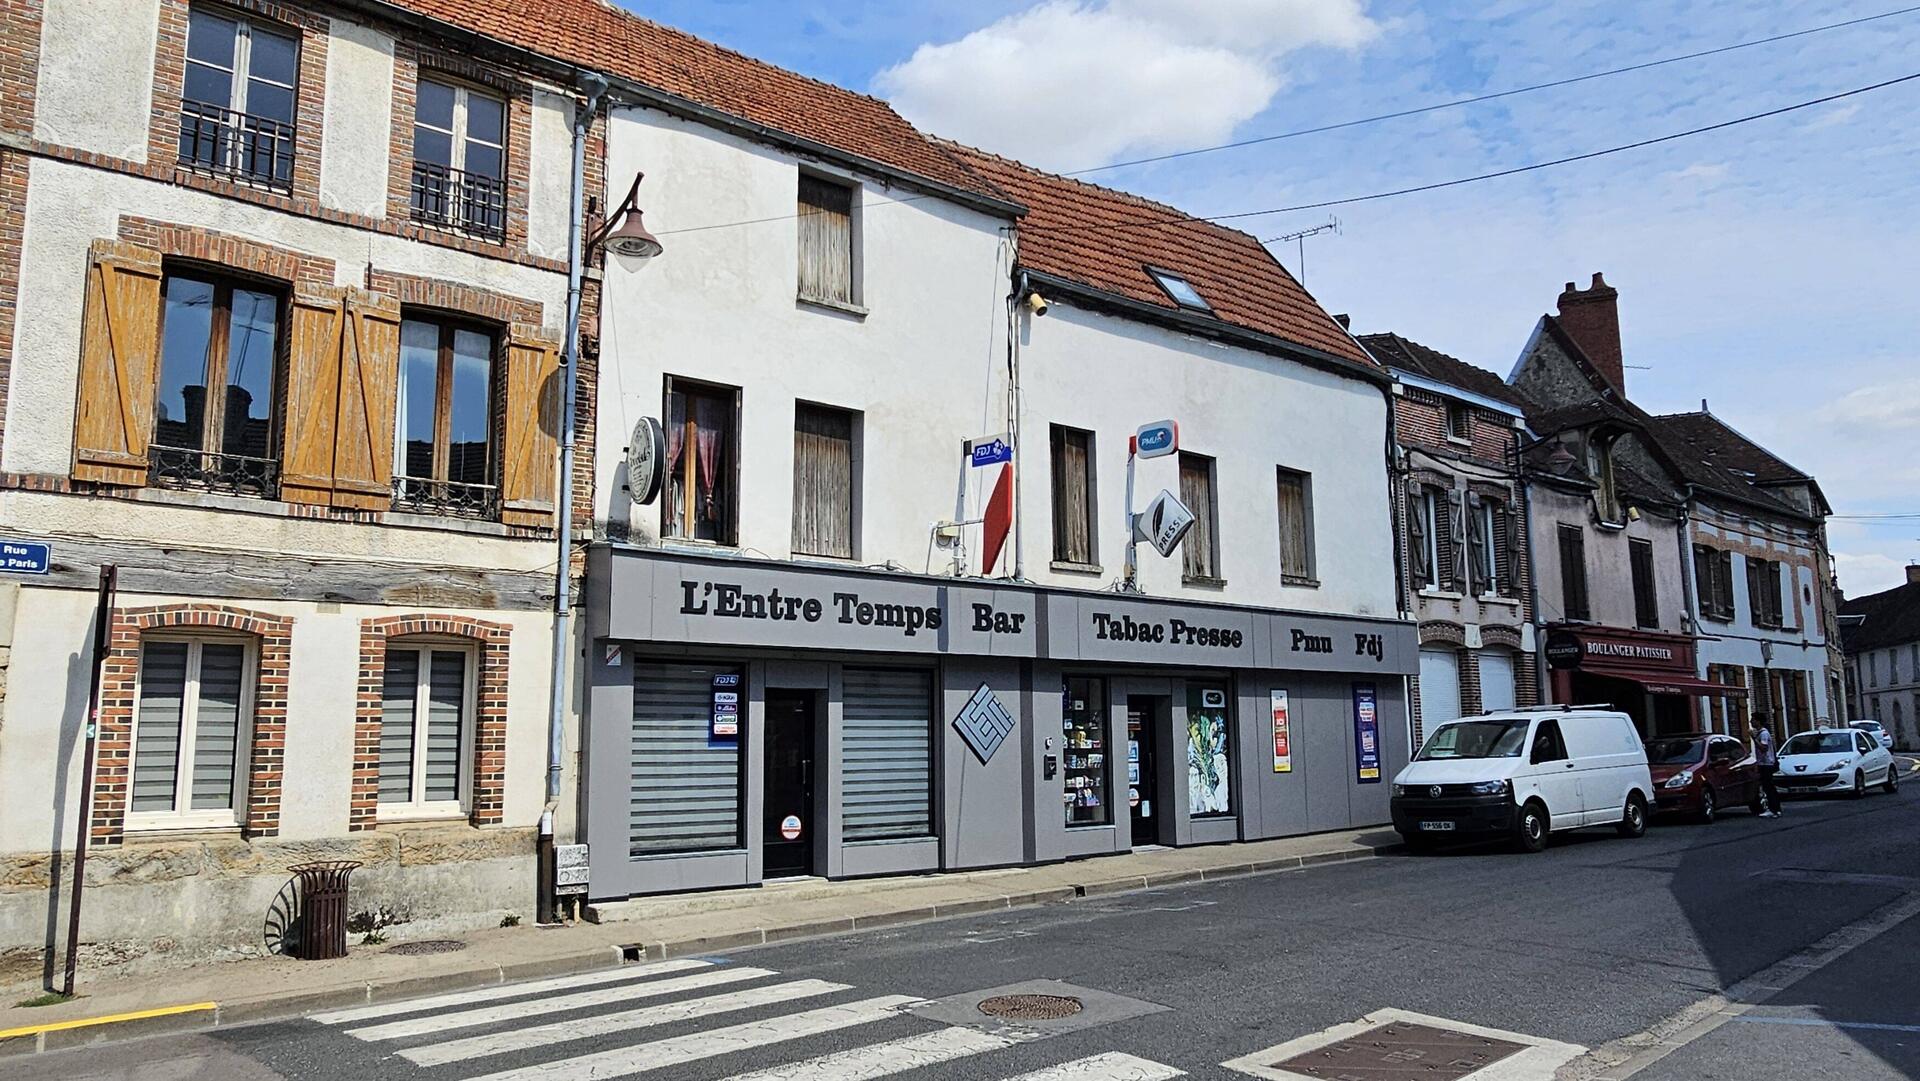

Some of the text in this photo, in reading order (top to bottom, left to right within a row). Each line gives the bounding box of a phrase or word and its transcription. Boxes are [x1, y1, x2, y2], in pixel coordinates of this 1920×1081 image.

[1141, 435, 1158, 446] PMU
[976, 445, 991, 457] FDJ
[1158, 515, 1186, 551] PRESSE
[4, 545, 28, 555] Rue
[8, 558, 38, 568] Paris
[680, 580, 1026, 637] L'Entre Temps Bar
[1092, 612, 1243, 649] Tabac Presse
[1290, 628, 1384, 662] Pmu Fdj
[1587, 642, 1673, 660] BOULANGER PATISSIER
